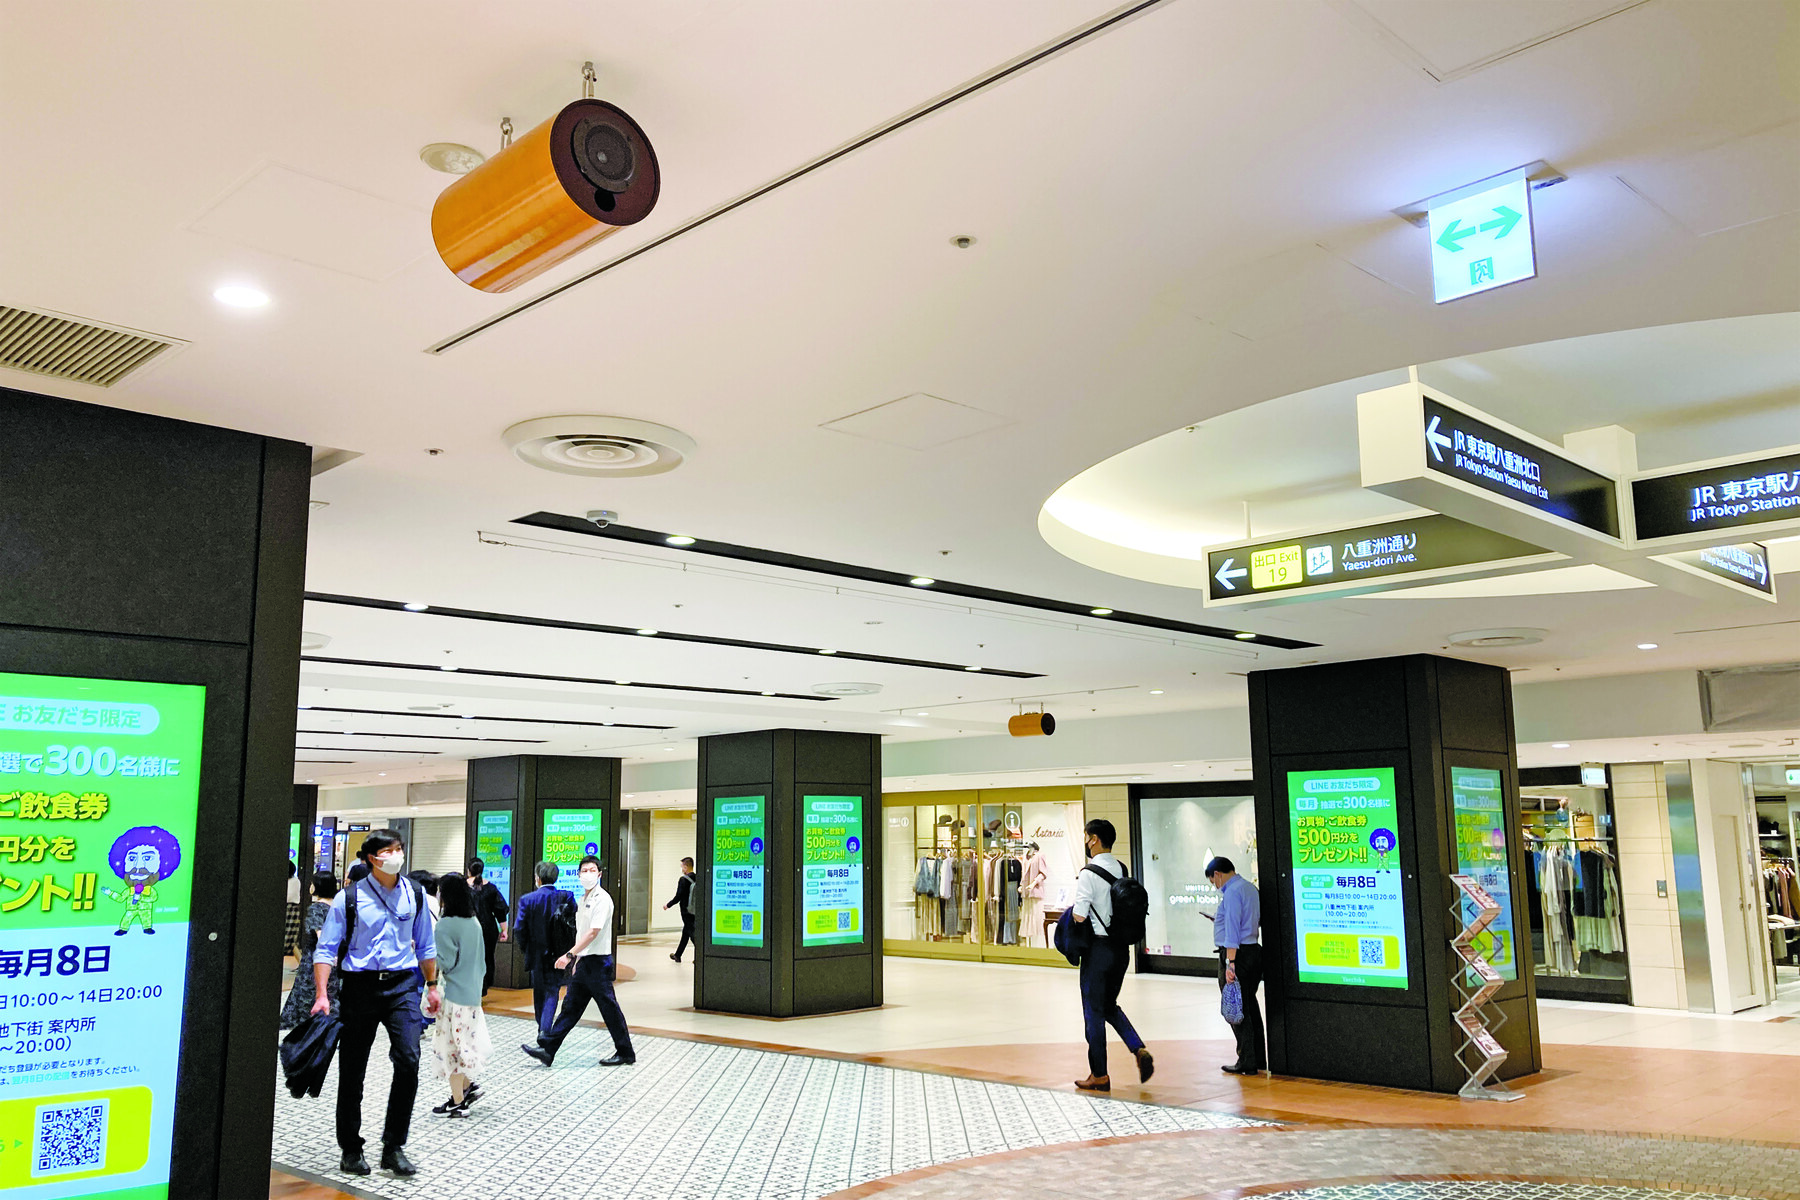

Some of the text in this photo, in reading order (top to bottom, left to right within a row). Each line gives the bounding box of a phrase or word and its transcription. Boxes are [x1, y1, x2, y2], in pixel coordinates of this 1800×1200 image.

[1454, 429, 1541, 483] JR 東京駅八重洲北口
[1455, 453, 1549, 500] JR Tokyo Station Yaesu North Exit
[1692, 485, 1717, 508] JR
[1690, 494, 1800, 522] JR Tokyo Station
[1341, 532, 1418, 560] 八重洲通り
[1254, 550, 1299, 568] 出口 Exit
[1342, 552, 1418, 572] Yaesu-dori Ave.
[1269, 567, 1288, 583] 19
[12, 704, 141, 728] お友だち限定
[1311, 782, 1329, 790] LINE
[1299, 828, 1359, 846] 500円分を
[0, 873, 96, 912] ント!!
[1337, 876, 1376, 888] 毎月8日
[1169, 895, 1219, 905] green label
[0, 945, 111, 979] 毎月8日
[48, 1016, 96, 1034] 案内所
